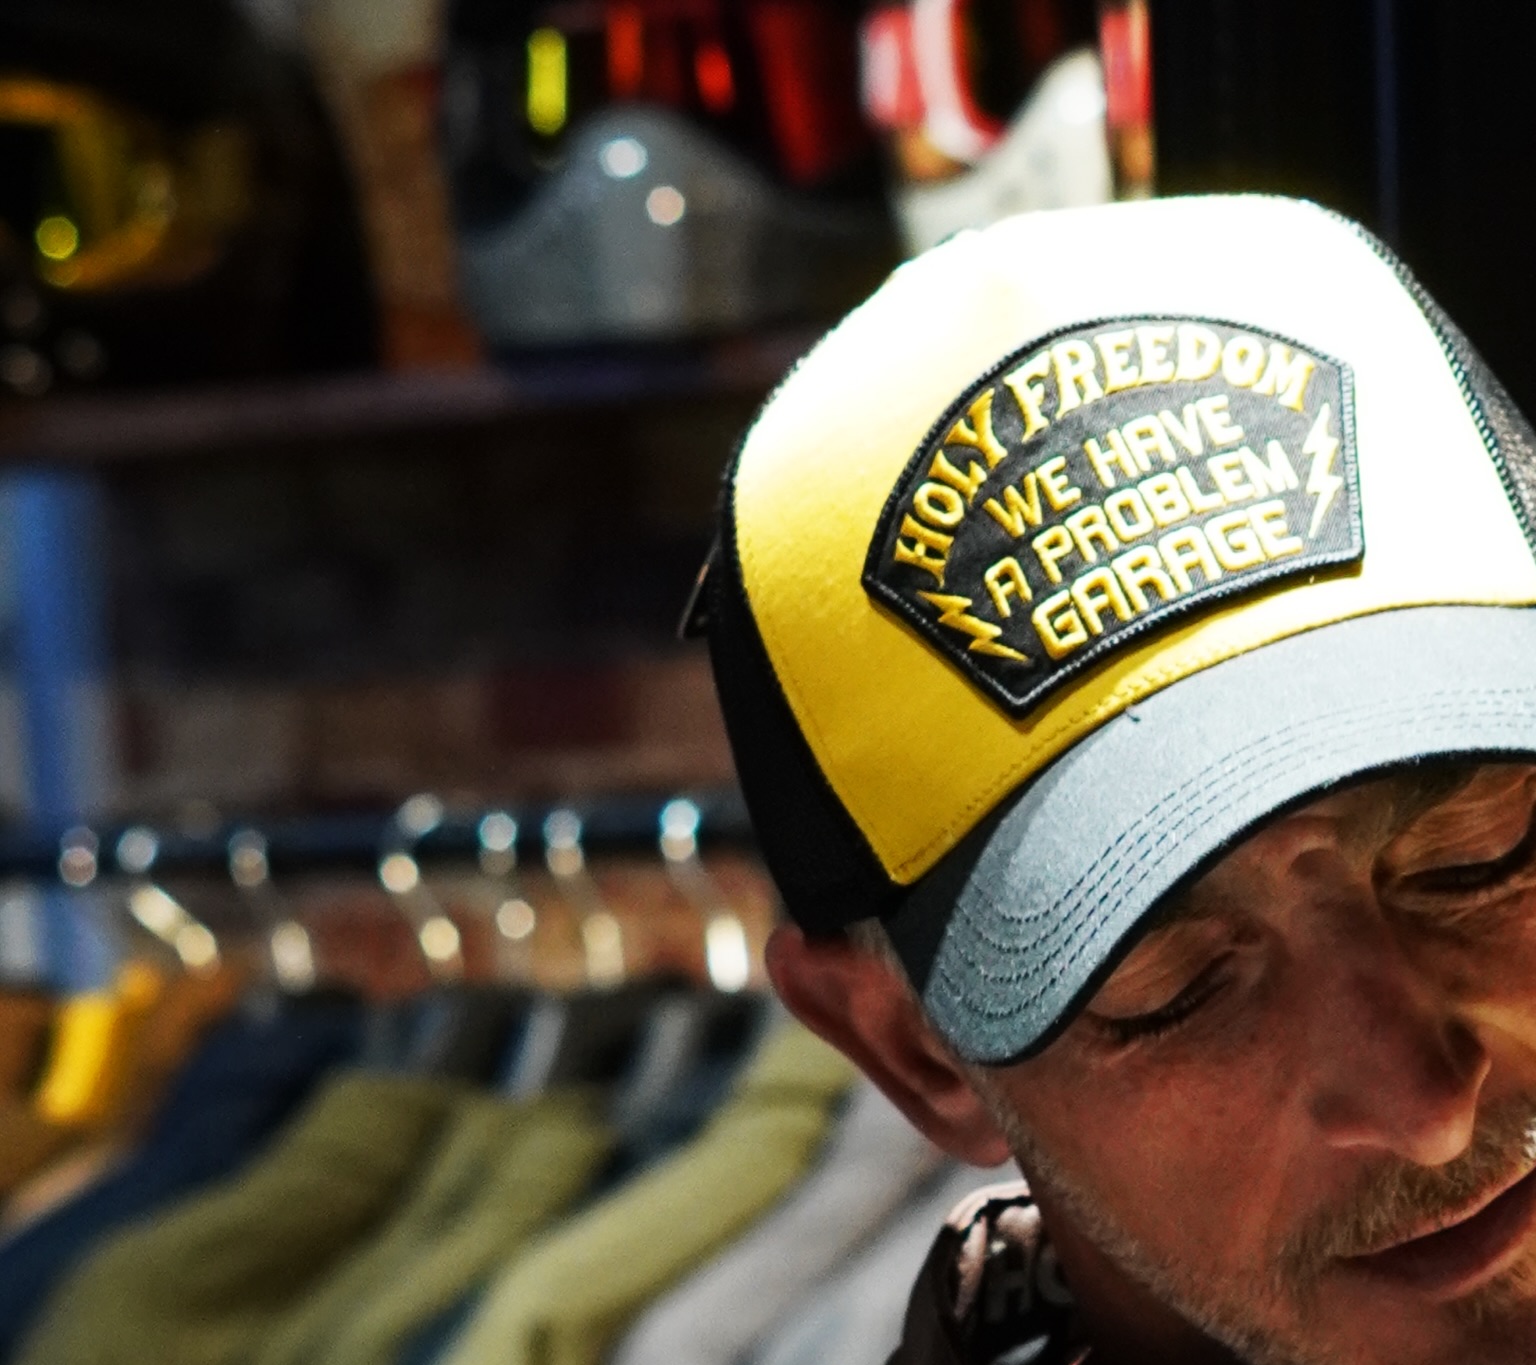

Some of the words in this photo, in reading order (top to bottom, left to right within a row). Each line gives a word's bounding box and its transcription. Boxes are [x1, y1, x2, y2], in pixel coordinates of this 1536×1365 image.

[893, 388, 1008, 588] HOLY
[1004, 324, 1316, 442] FREEDOM
[983, 455, 1081, 538] WE
[1083, 394, 1244, 489] HAVE
[983, 556, 1032, 618] A
[1031, 440, 1300, 584] PROBLEM
[1031, 499, 1303, 661] GARAGE
